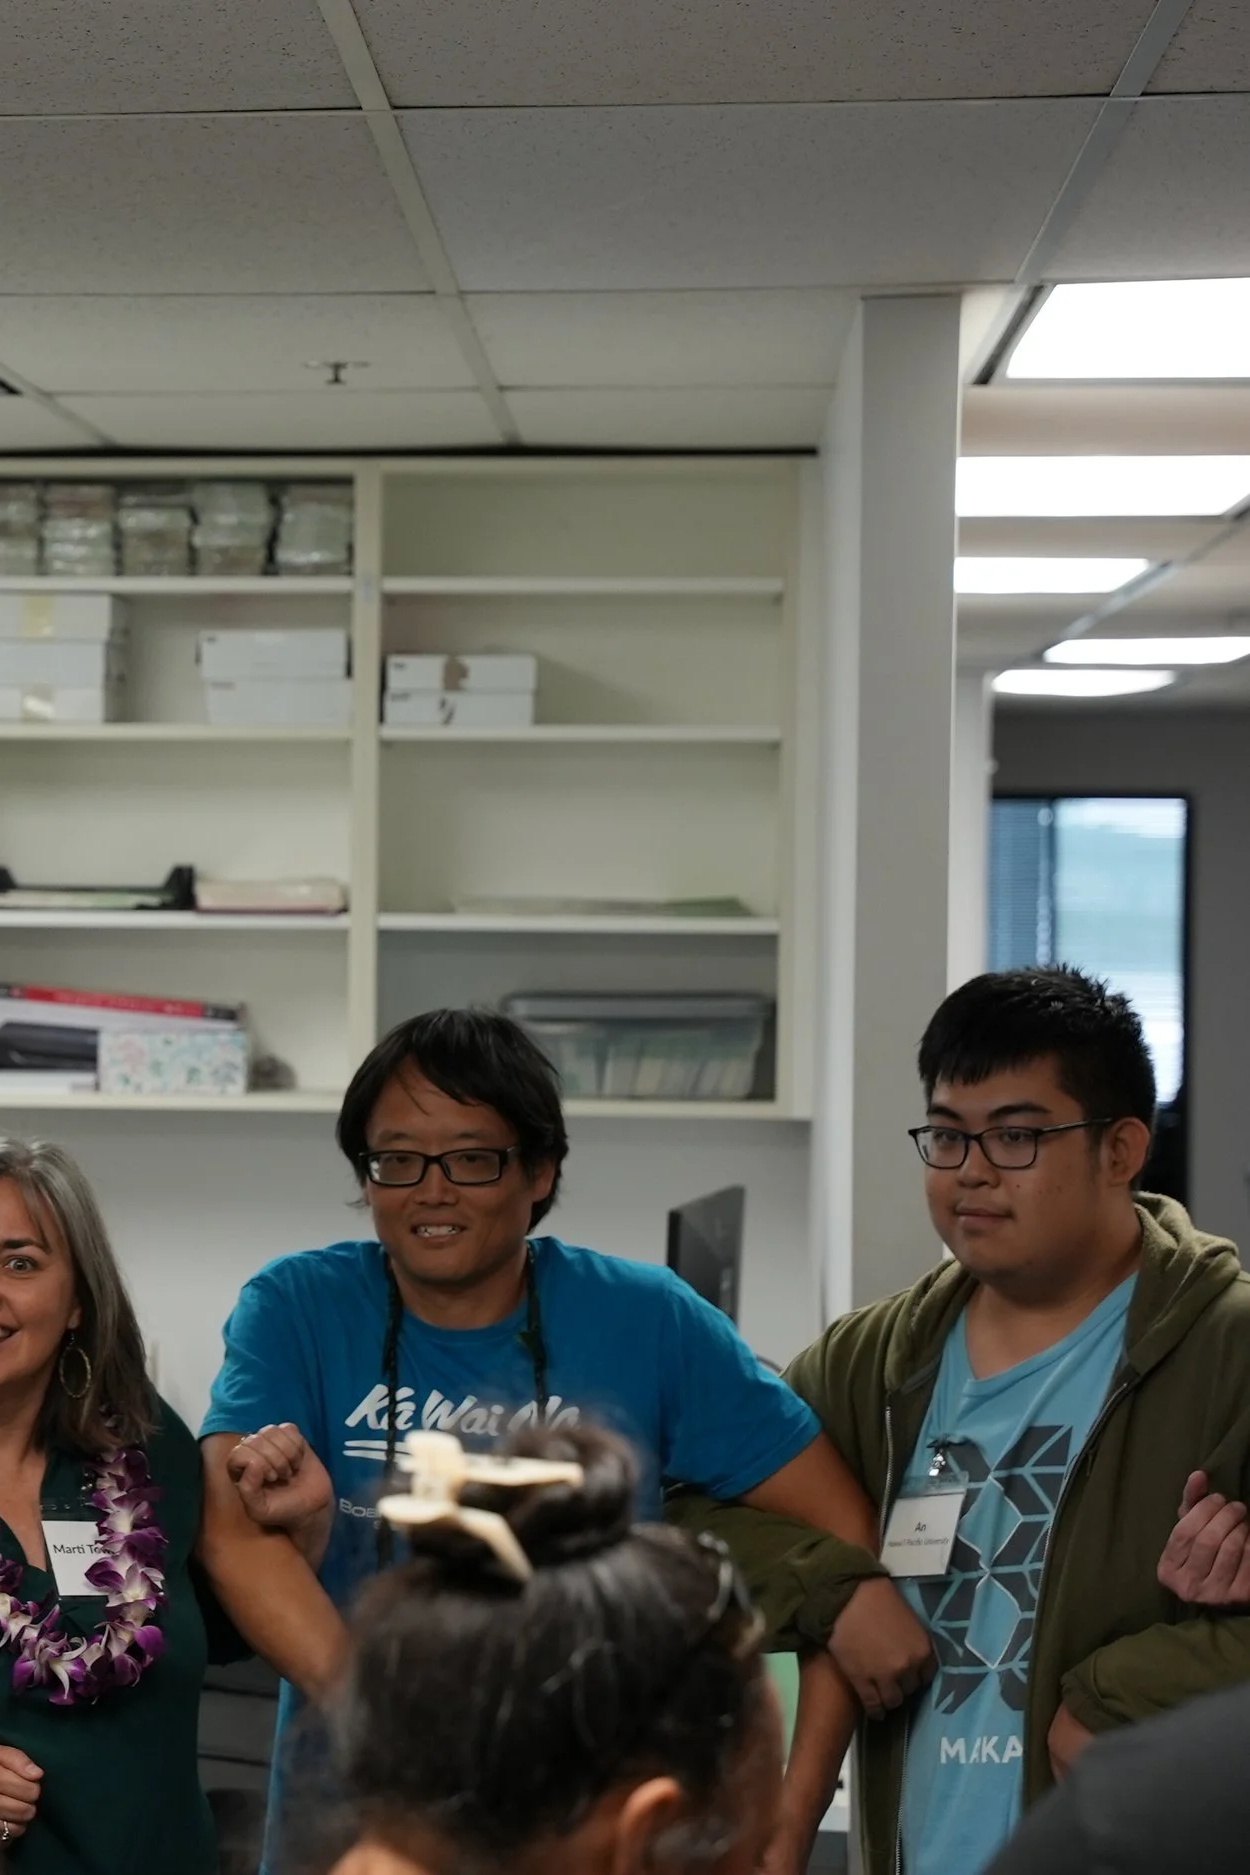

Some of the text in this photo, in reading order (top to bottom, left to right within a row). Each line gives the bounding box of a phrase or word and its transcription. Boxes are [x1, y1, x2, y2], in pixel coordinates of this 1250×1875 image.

[422, 1389, 505, 1437] Wai
[914, 1521, 927, 1533] An
[53, 1544, 85, 1555] Marti
